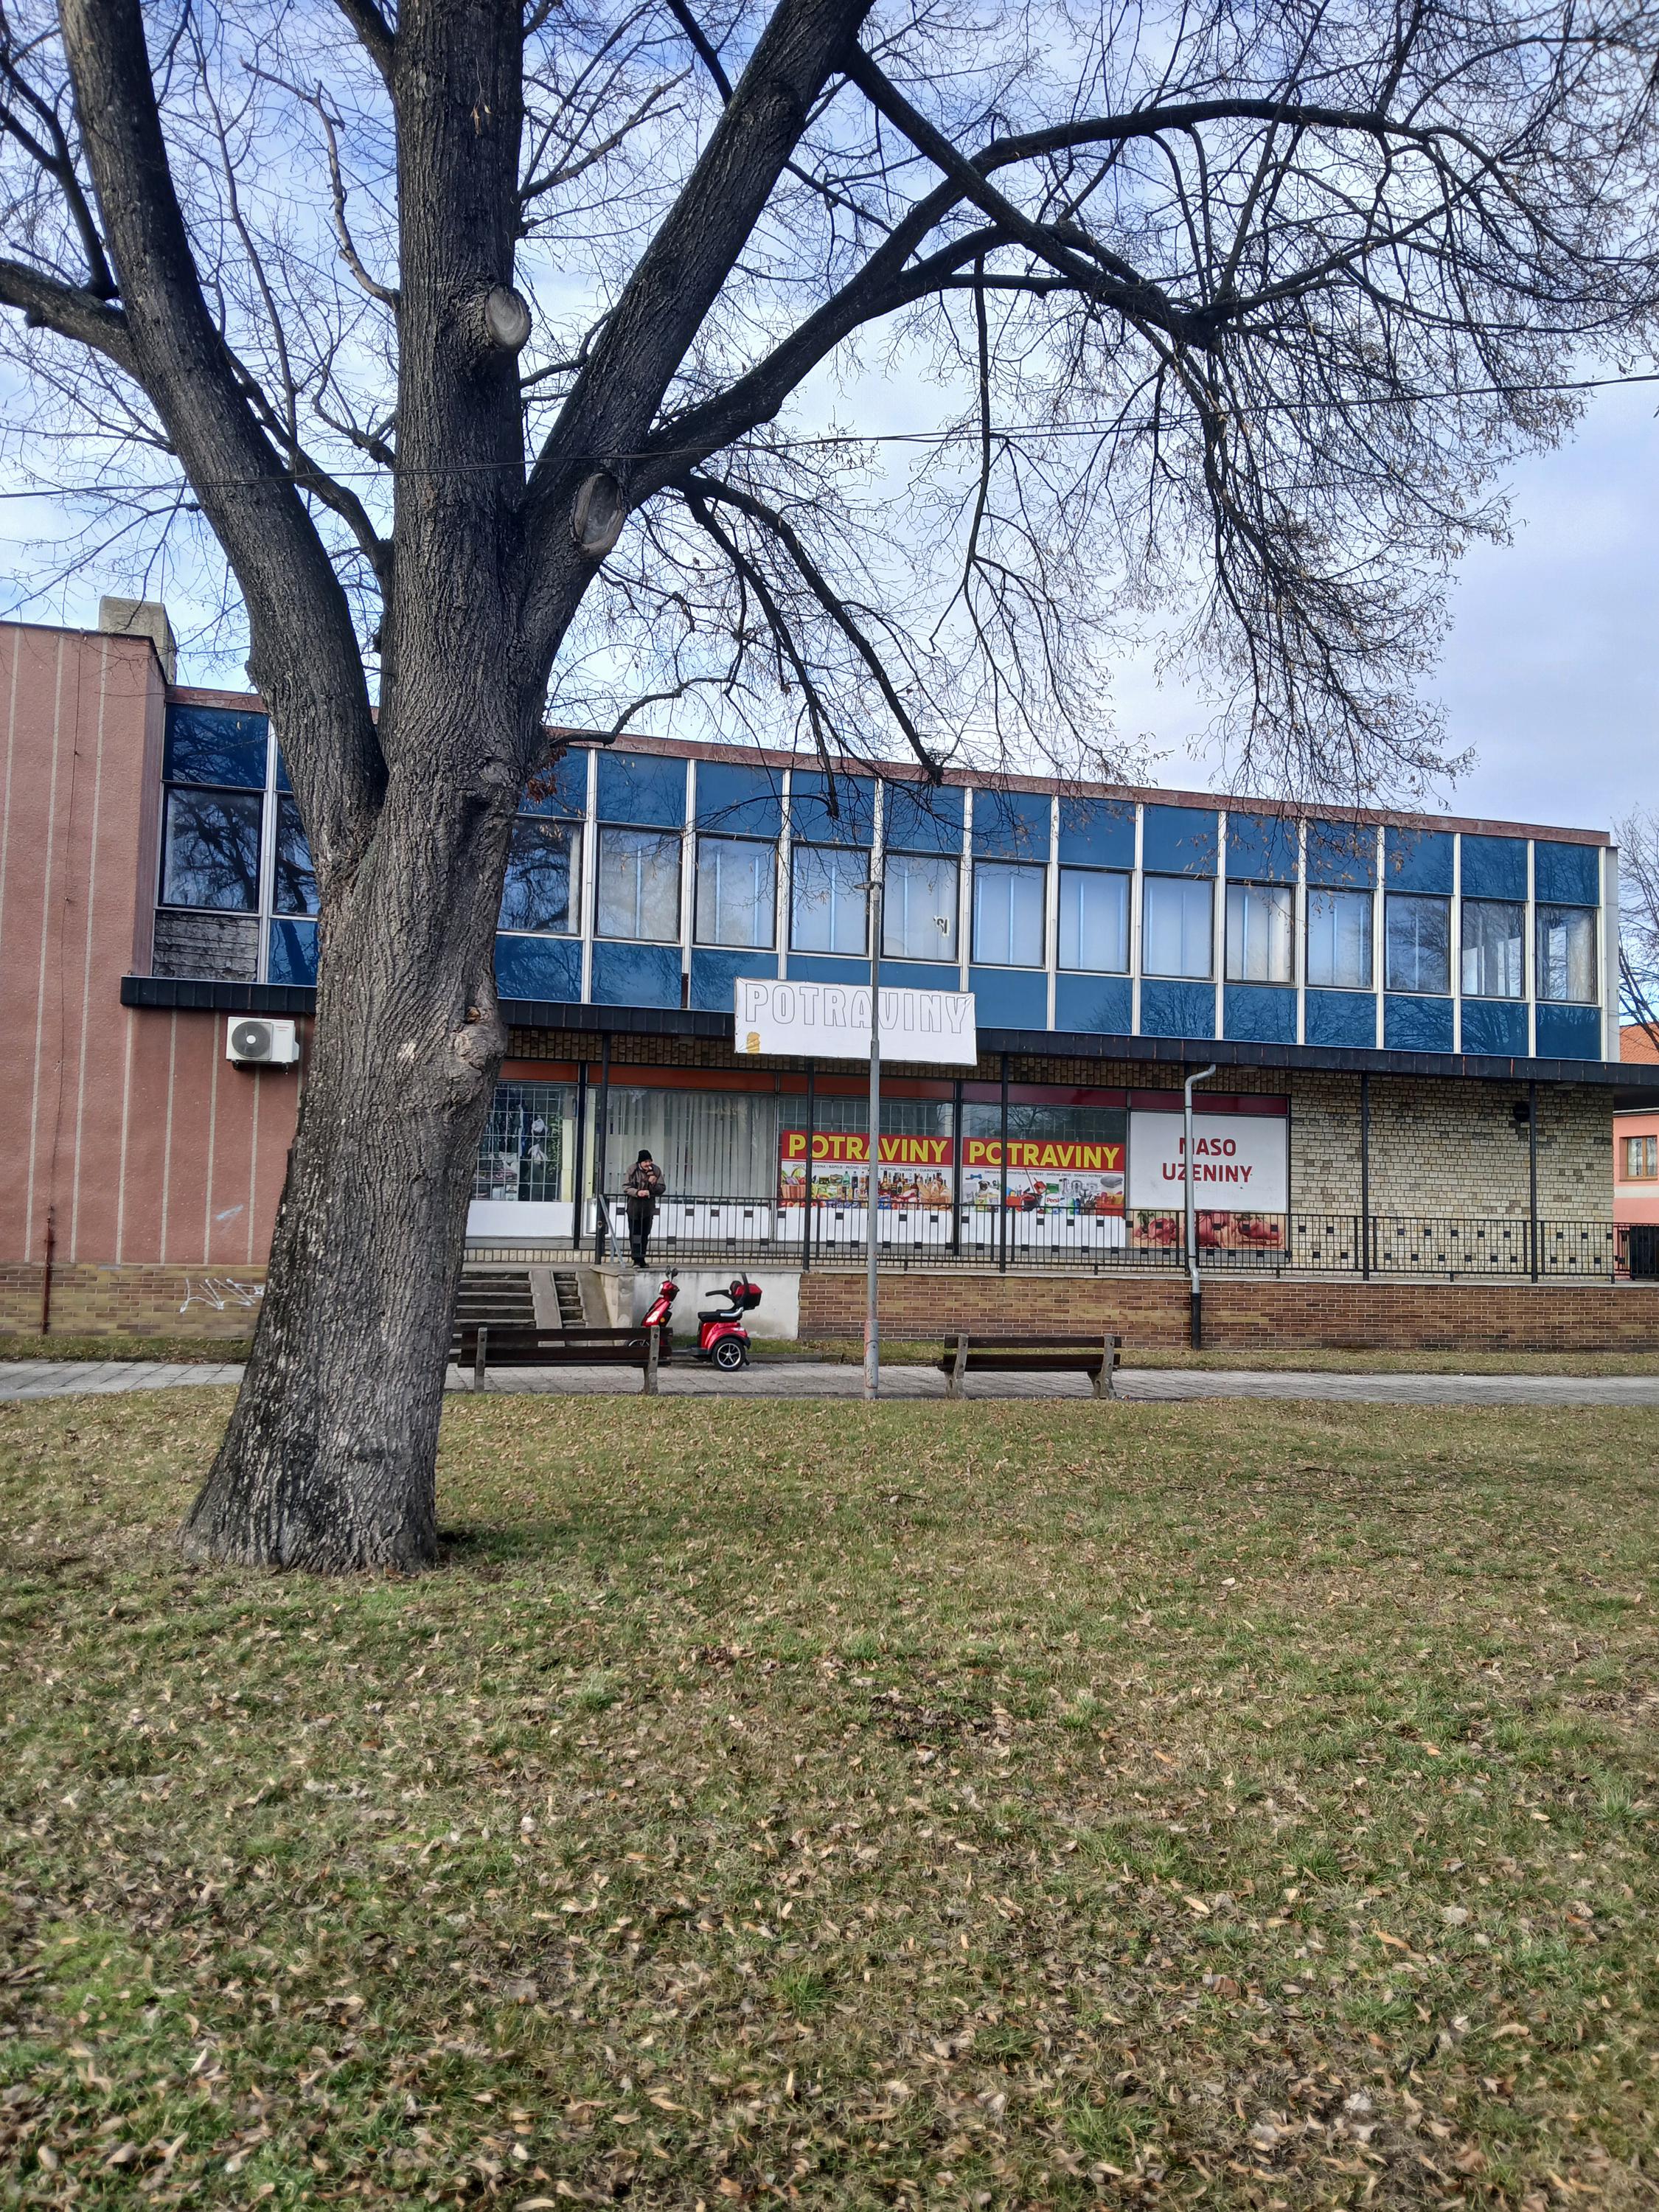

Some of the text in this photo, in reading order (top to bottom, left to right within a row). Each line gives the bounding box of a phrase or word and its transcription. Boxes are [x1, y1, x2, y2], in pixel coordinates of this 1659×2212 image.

[745, 983, 967, 1034] POTRAVINY
[969, 1141, 1120, 1169] POTRAVINY
[1162, 1163, 1252, 1183] UZENINY
